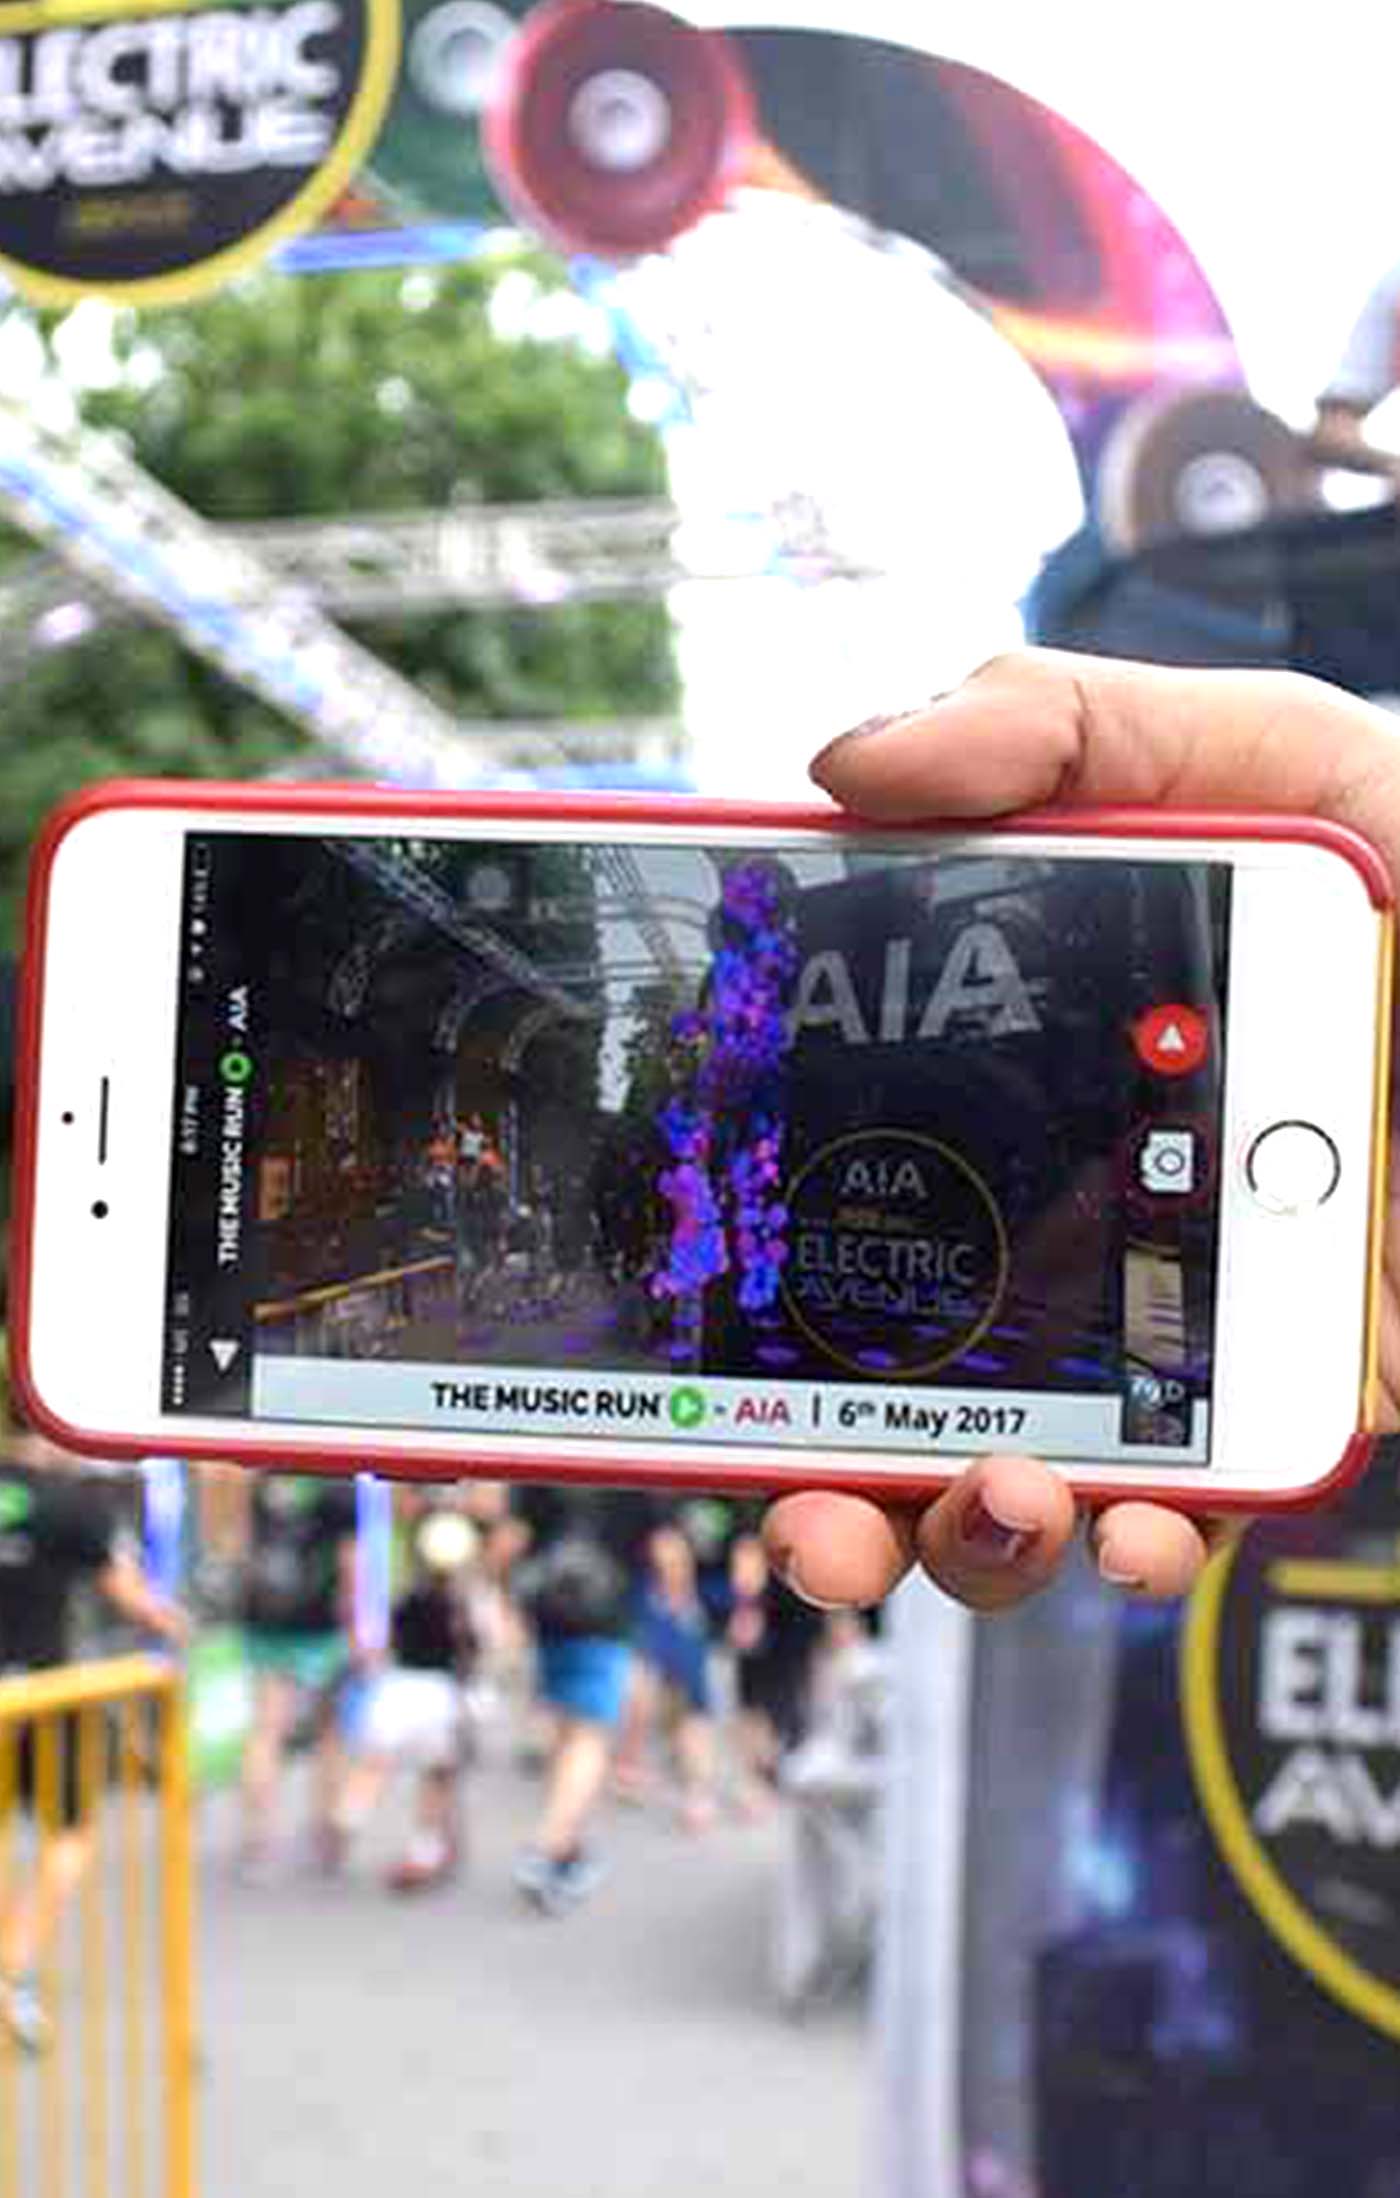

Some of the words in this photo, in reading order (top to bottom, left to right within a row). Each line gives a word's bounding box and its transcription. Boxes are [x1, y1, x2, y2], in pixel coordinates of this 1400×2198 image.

[228, 986, 248, 1032] AIA
[782, 921, 1042, 1047] AIA
[222, 1086, 244, 1138] RUN
[220, 1141, 242, 1216] MUSIC
[839, 1160, 928, 1198] AIA
[217, 1217, 240, 1265] THE
[798, 1233, 976, 1287] ELECTRIC
[430, 1382, 490, 1411] THE
[496, 1384, 589, 1417] MUSIC
[596, 1390, 661, 1419] RUN
[735, 1397, 791, 1427] AIA
[837, 1400, 876, 1429] 6th
[884, 1403, 949, 1438] May
[956, 1406, 1028, 1436] 2017
